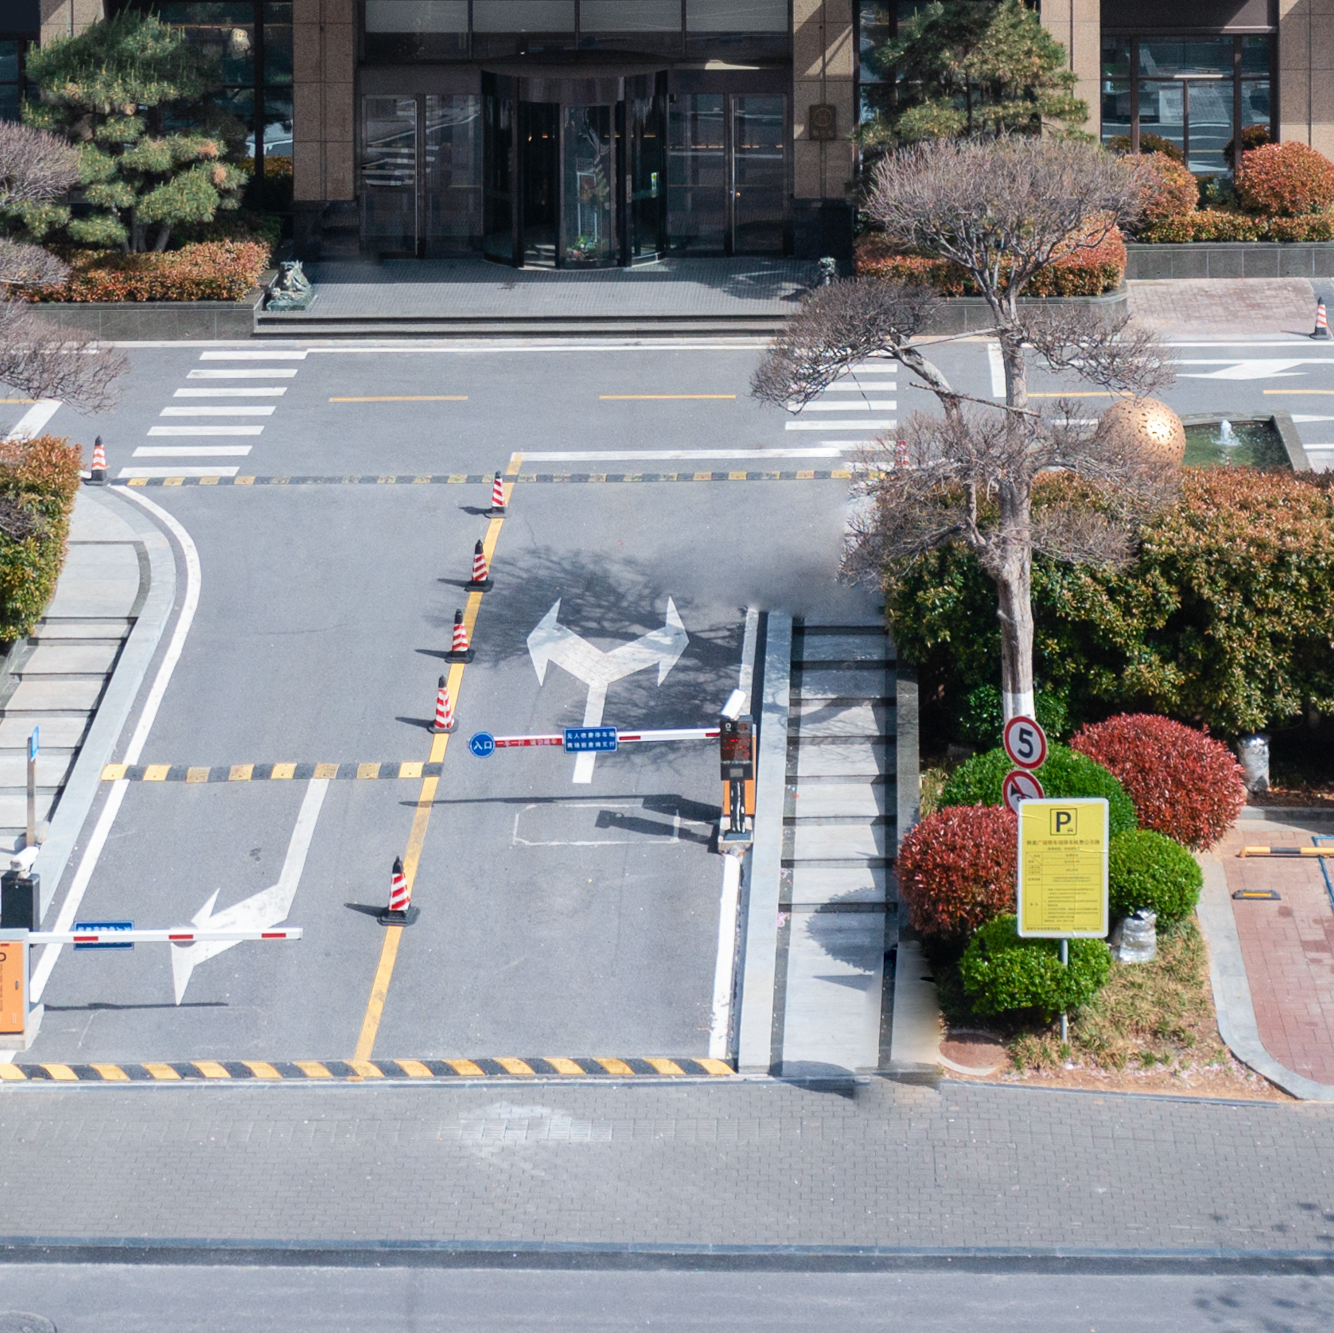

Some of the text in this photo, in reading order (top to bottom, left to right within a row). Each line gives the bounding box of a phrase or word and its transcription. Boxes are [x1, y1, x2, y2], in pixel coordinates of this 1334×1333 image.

[473, 741, 492, 751] 入口
[1017, 728, 1034, 759] 5
[1056, 811, 1072, 833] P
